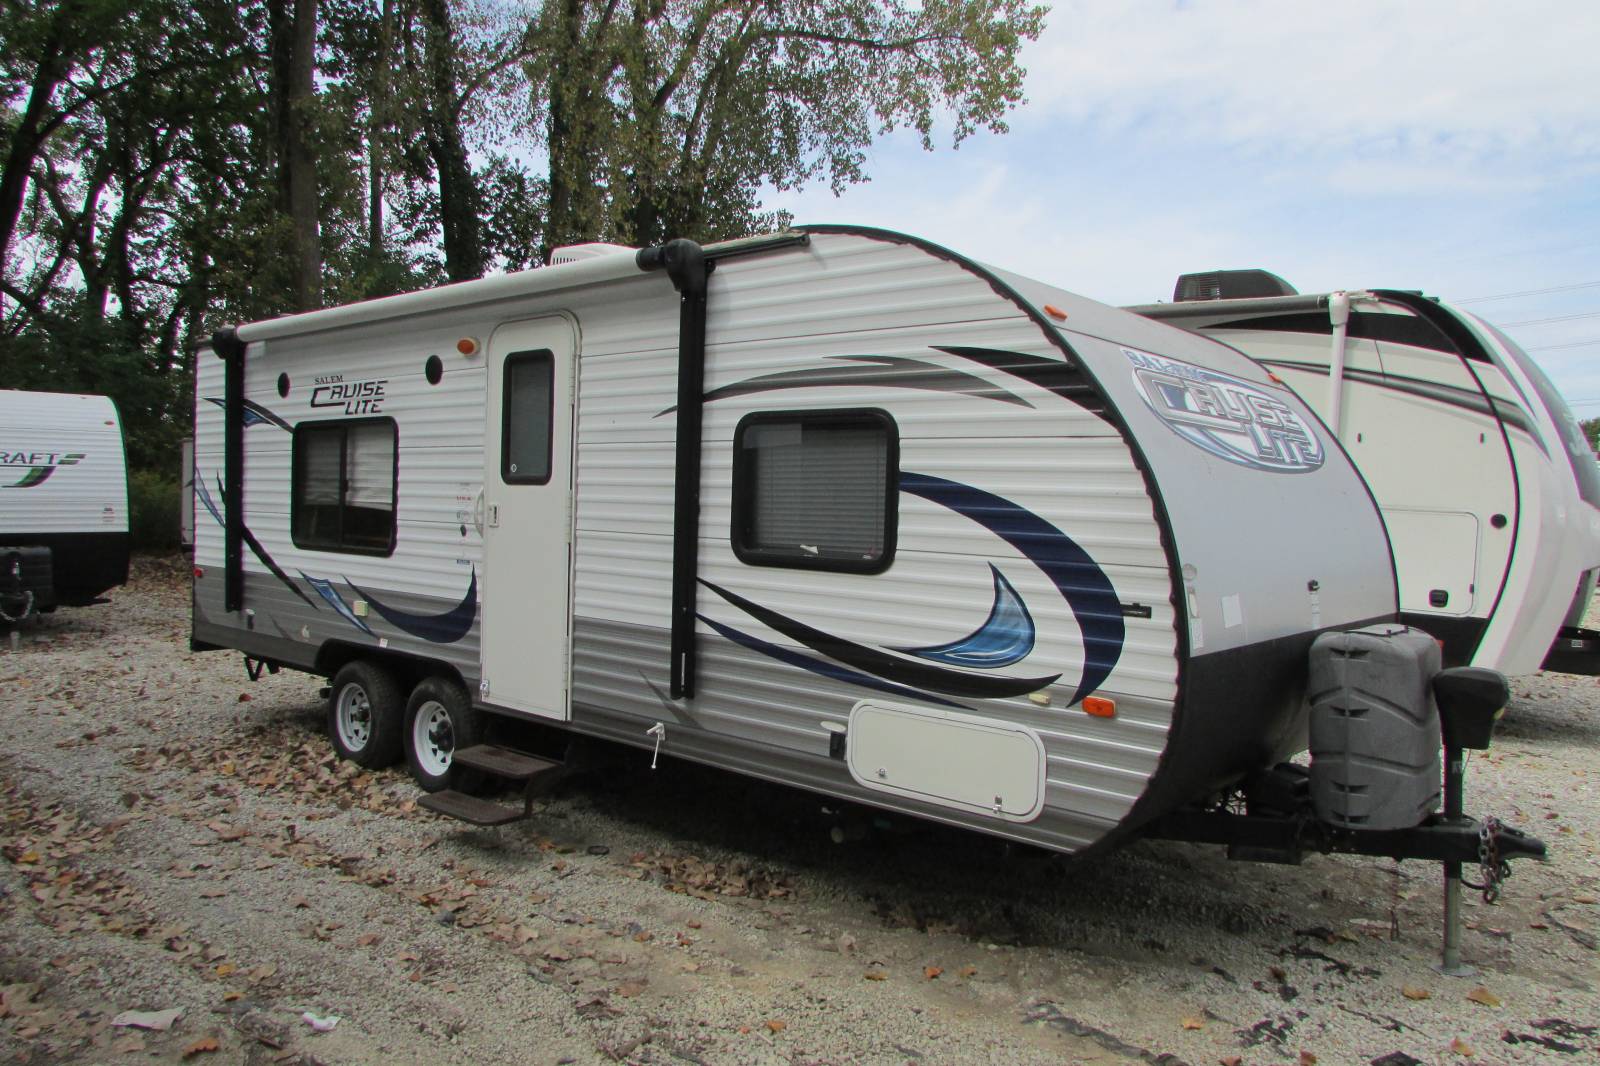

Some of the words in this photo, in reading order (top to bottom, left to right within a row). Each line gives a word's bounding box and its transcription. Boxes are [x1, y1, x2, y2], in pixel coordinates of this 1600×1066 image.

[310, 380, 388, 408] CRUISE
[314, 375, 344, 385] SALEM
[345, 398, 384, 415] LITE
[1134, 366, 1302, 433] CRUISE
[1246, 424, 1323, 465] LITE
